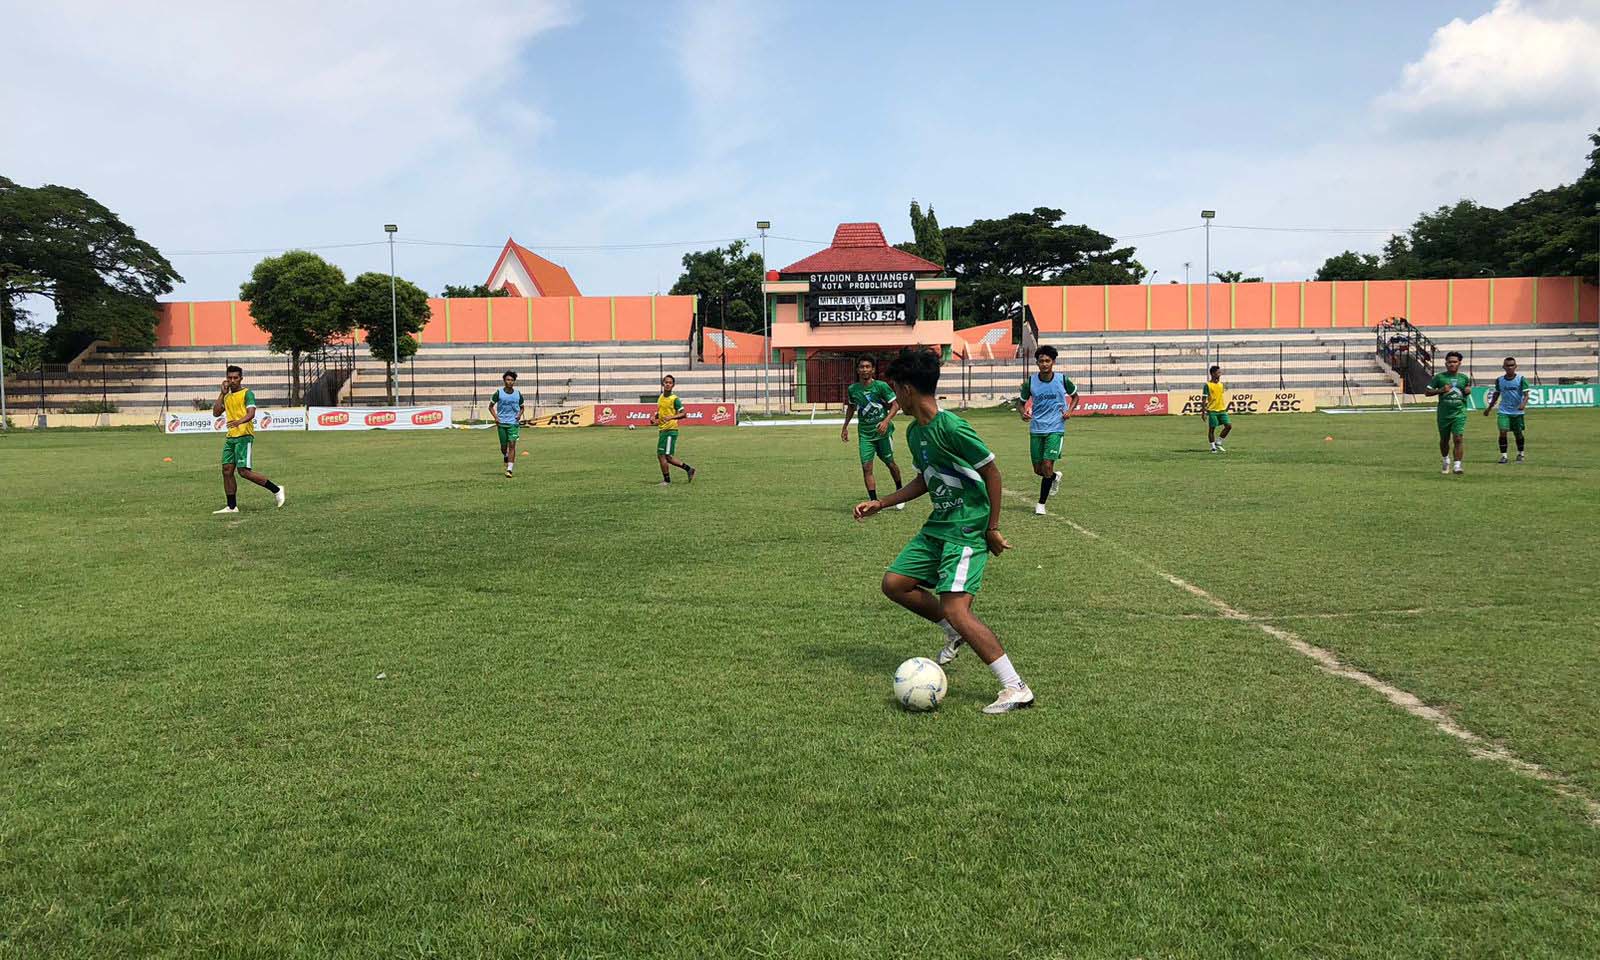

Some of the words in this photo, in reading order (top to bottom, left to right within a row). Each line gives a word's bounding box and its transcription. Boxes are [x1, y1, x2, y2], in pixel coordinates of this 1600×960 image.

[810, 274, 851, 282] STADION
[857, 273, 915, 282] BAYUANGGA
[820, 296, 843, 304] MITRA
[845, 296, 867, 304] BOLA
[868, 296, 894, 304] UTAMA
[820, 311, 878, 321] PERSIPRO
[881, 311, 895, 320] 54
[1545, 388, 1594, 404] JATIM
[1084, 402, 1108, 410] lebih
[1111, 402, 1135, 410] enak
[1226, 400, 1259, 412] ABC
[1268, 400, 1301, 411] ABC
[272, 415, 304, 425] mangga
[547, 414, 580, 425] ABC
[626, 411, 651, 419] Jelas
[181, 419, 210, 429] mangga
